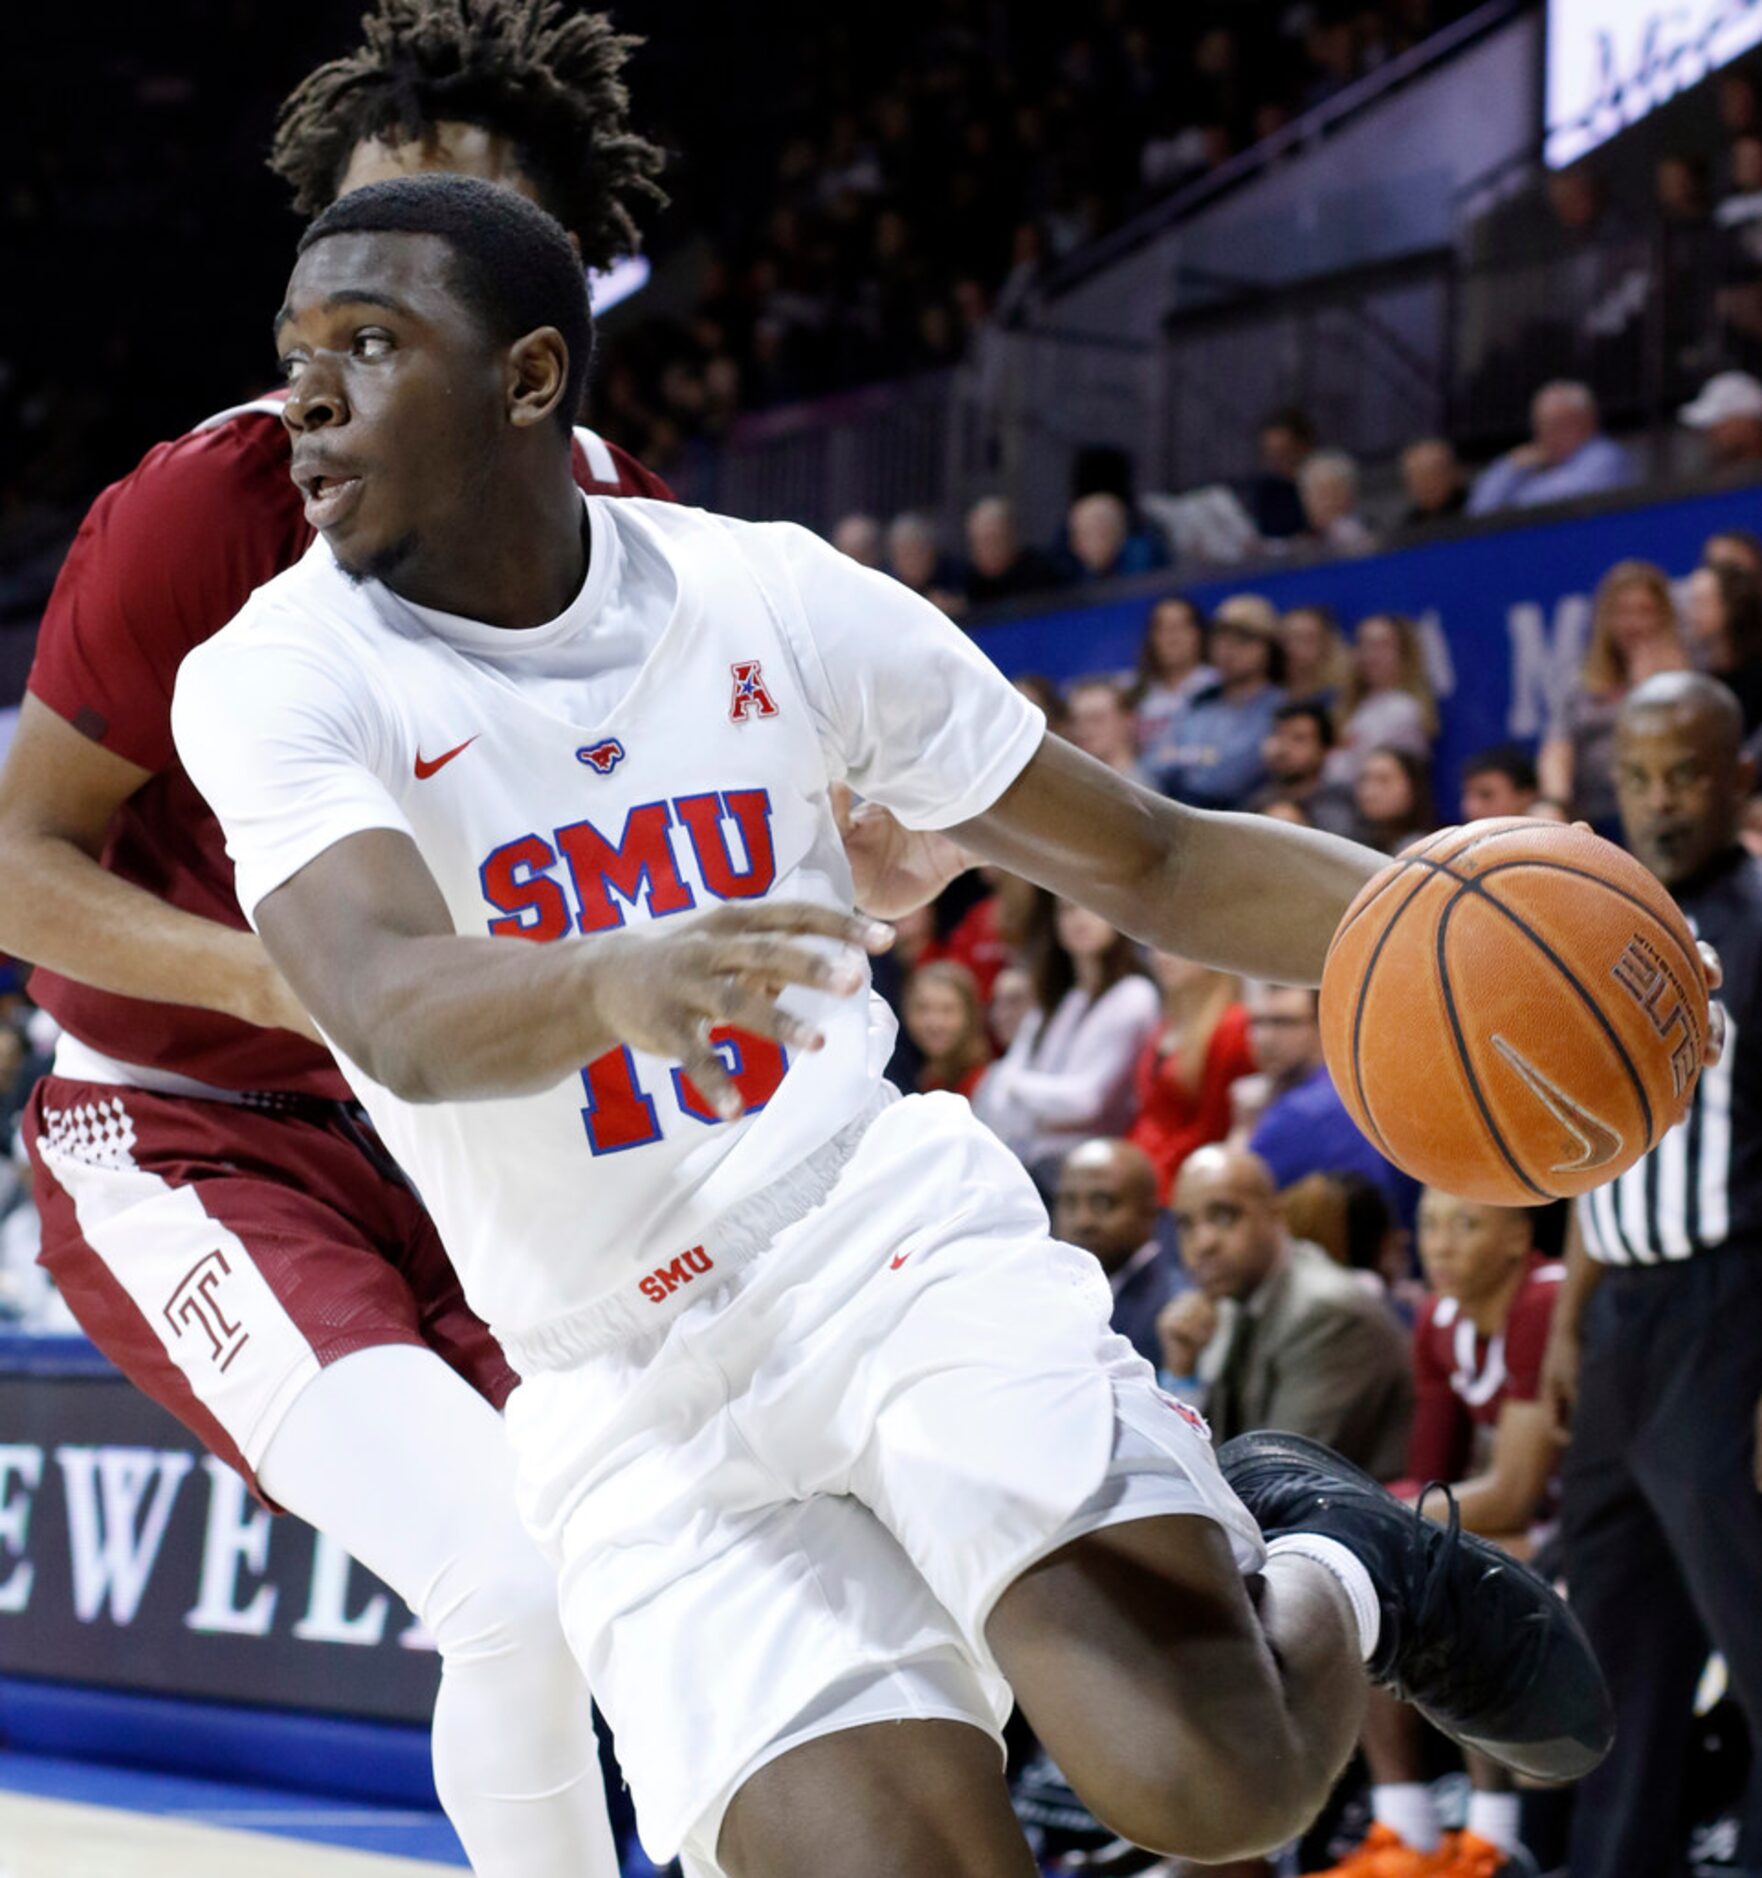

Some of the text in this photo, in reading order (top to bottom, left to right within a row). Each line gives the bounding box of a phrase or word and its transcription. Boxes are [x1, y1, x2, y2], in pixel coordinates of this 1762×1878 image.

[479, 788, 776, 944] SMU
[1610, 941, 1698, 1099] ELITE
[163, 1248, 250, 1374] T
[638, 1244, 714, 1304] SMU
